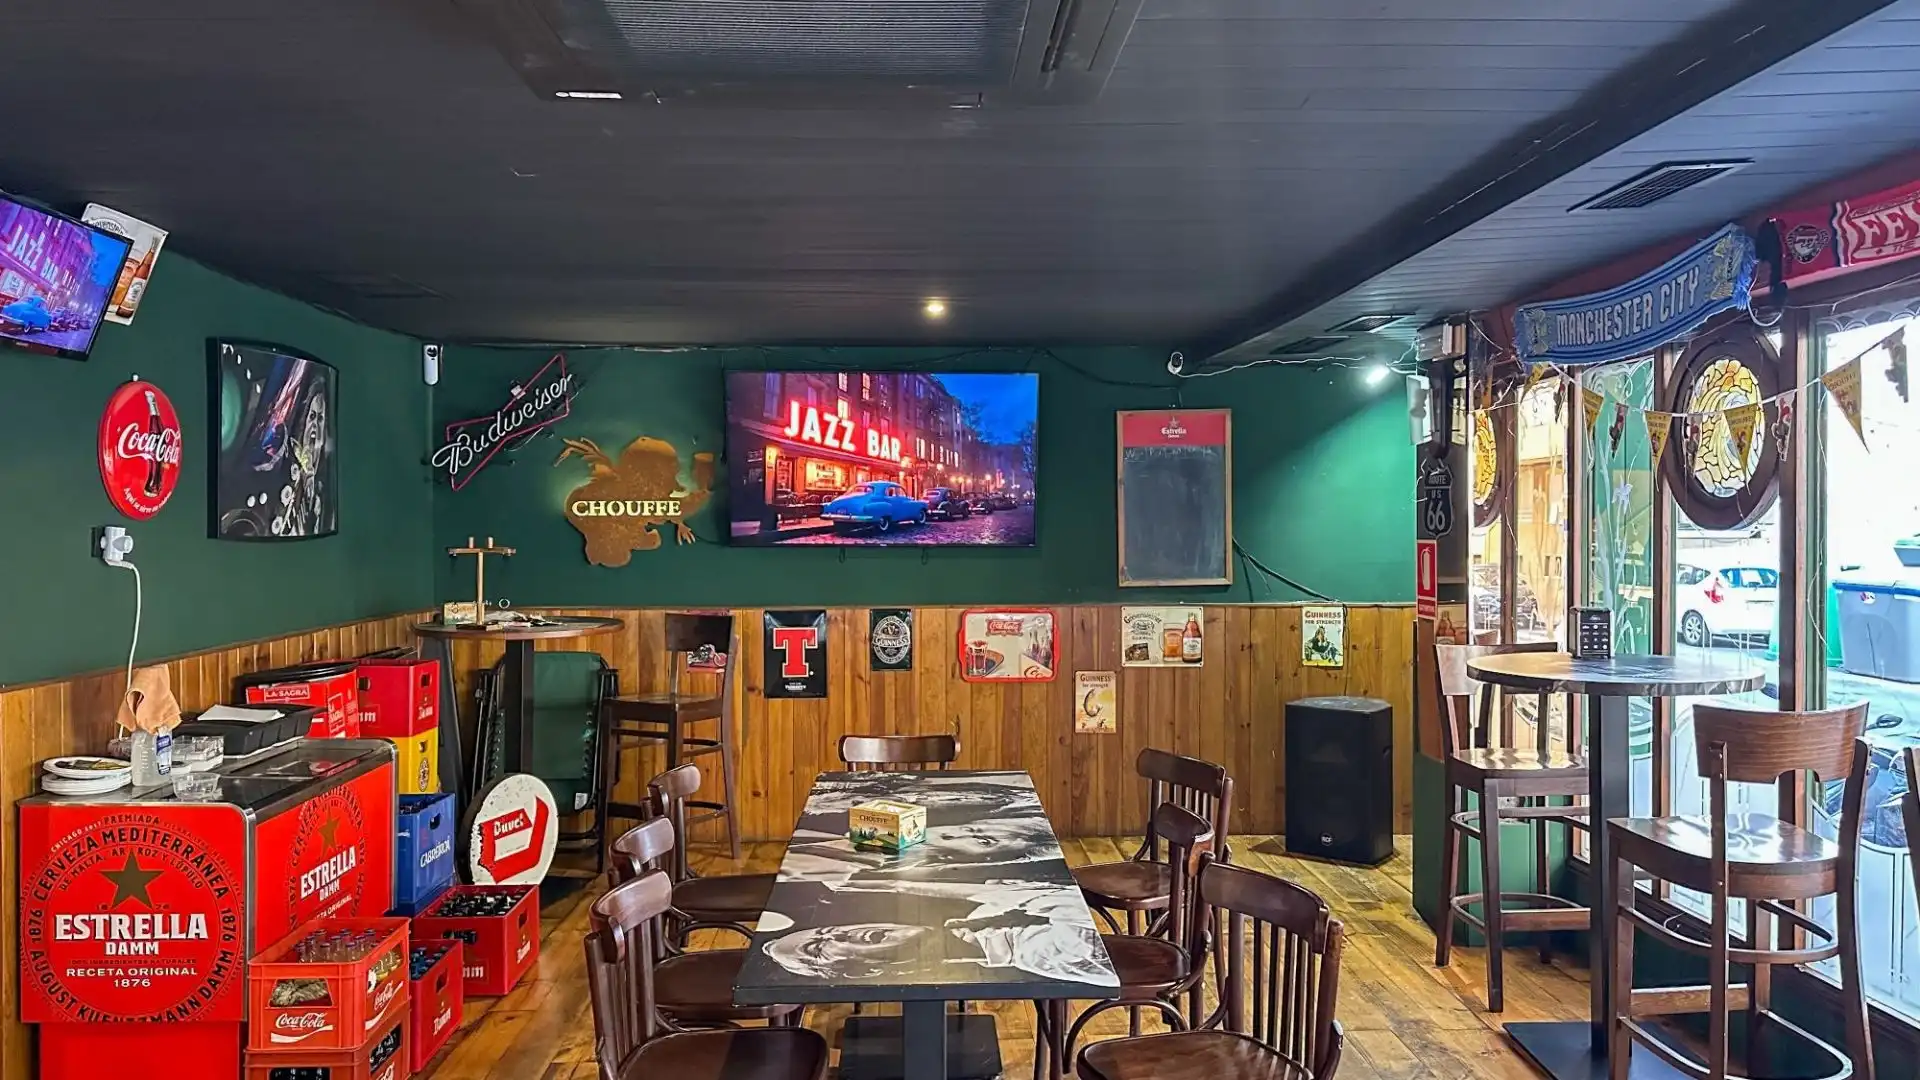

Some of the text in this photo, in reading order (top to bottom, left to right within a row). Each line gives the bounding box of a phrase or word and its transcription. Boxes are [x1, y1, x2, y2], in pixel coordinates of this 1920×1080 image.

[7, 223, 59, 287] JAZZ BAR
[1556, 293, 1653, 348] MANCHESTER
[1660, 265, 1700, 323] CITY
[431, 374, 573, 475] Budweiser
[783, 399, 902, 462] JAZZ BAR
[1161, 427, 1187, 435] Estrella
[1428, 474, 1447, 485] ROUTE
[571, 500, 682, 517] CHOUFFE
[1426, 503, 1446, 531] 66
[1080, 673, 1112, 682] GUINNESS
[279, 689, 307, 697] SAGRA
[102, 813, 160, 826] PREMIADA
[51, 828, 82, 853] CHICAGO
[34, 835, 99, 901] CERVEZA
[102, 826, 229, 900] MEDITERRÁNEA
[301, 845, 356, 899] ESTRELLA
[319, 878, 340, 902] DAMM
[29, 908, 43, 944] 1876
[55, 912, 209, 940] ESTRELLA
[221, 907, 236, 942] 1876
[105, 941, 160, 956] DAMM
[31, 951, 77, 1011] AUGUST
[199, 949, 235, 1000] DAMM
[66, 967, 198, 977] RECETA ORIGINAL
[113, 979, 151, 988] 1876
[275, 1012, 328, 1029] Coca-Cola
